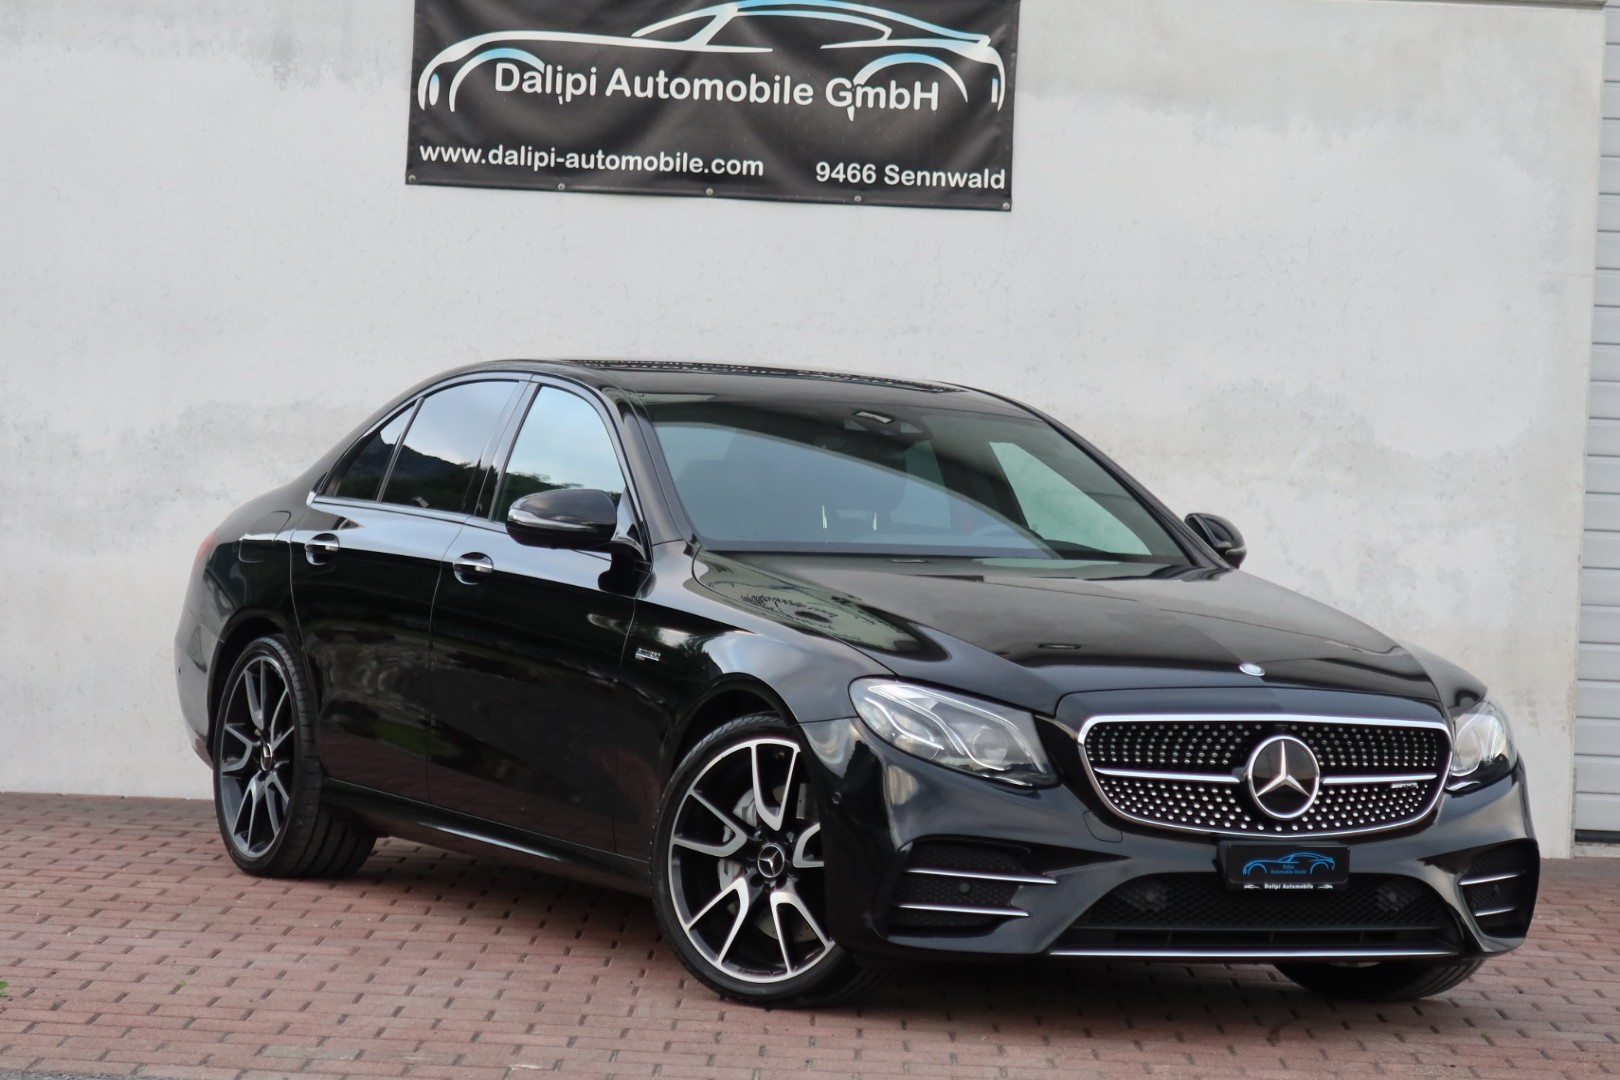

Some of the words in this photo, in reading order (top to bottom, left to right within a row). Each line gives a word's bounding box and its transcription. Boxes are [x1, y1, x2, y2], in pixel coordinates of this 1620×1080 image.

[495, 62, 597, 103] Dalipi
[605, 67, 814, 106] Automobile
[825, 77, 939, 111] GmbH
[419, 145, 764, 177] www.dalipi-automobile.com
[815, 161, 877, 183] 9466
[884, 164, 1006, 190] Sennwald
